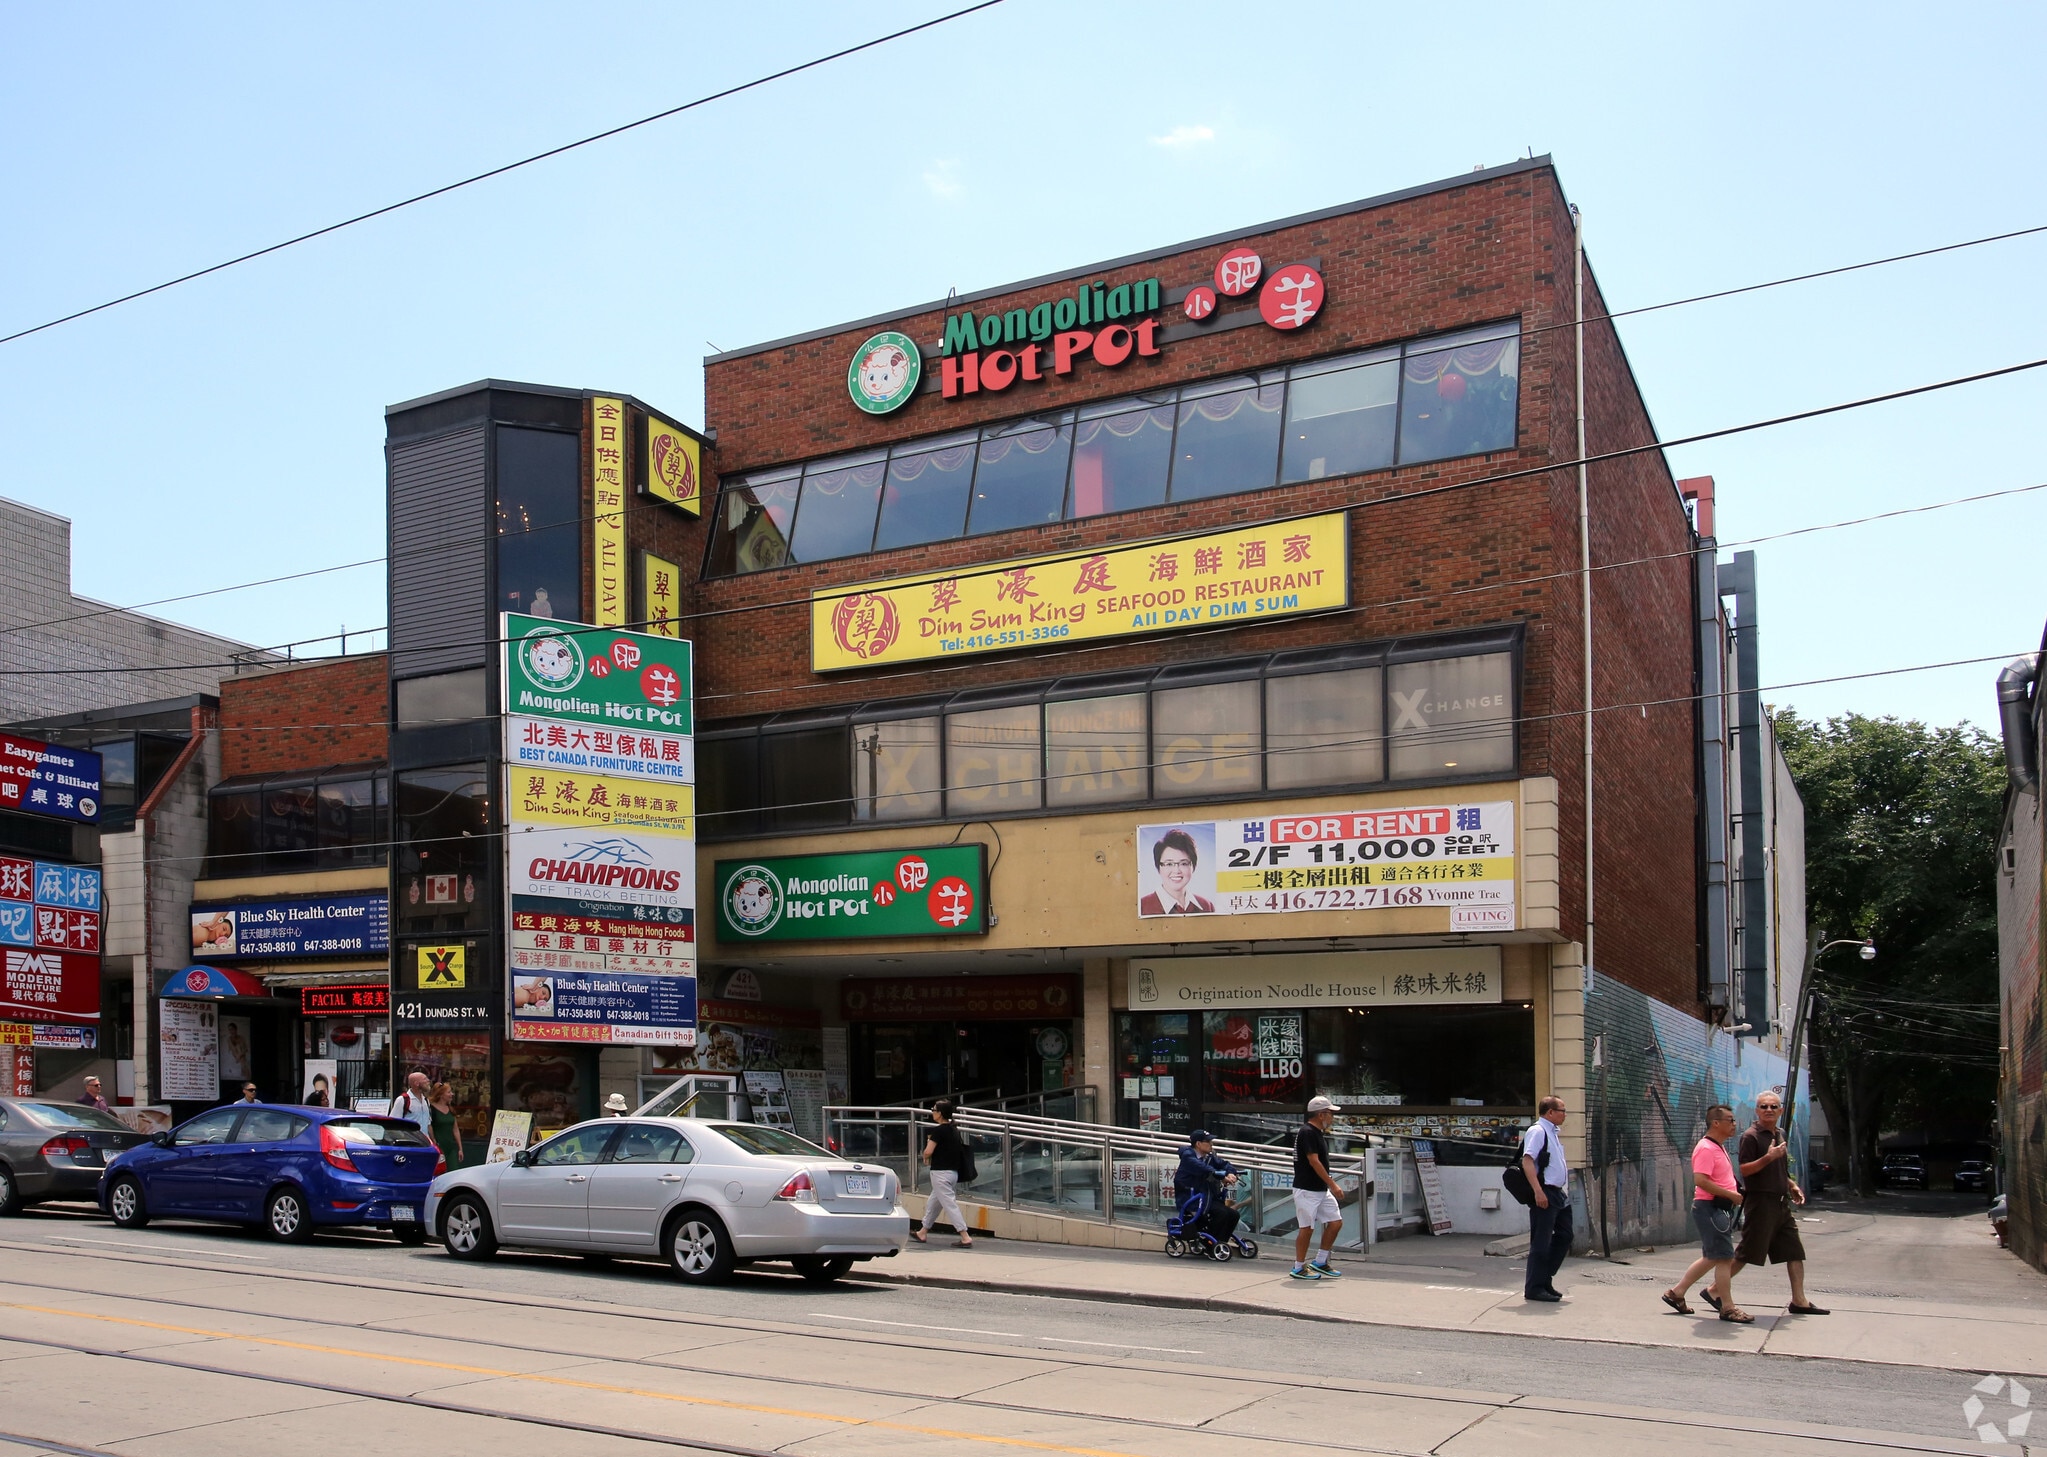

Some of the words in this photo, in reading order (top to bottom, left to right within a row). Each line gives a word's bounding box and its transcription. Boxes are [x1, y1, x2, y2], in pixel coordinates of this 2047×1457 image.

[1185, 256, 1317, 326] 小肥羊
[942, 277, 1160, 356] Mongolian
[941, 342, 1043, 398] Hot
[1054, 317, 1160, 375] Pot
[596, 403, 621, 530] 全日供應點心
[602, 537, 616, 571] ALL
[928, 555, 1117, 614] 翠濠庭
[1148, 534, 1312, 583] 海鮮酒家
[602, 577, 617, 617] DAY
[919, 615, 963, 638] Dim
[970, 608, 1022, 631] Sum
[1029, 601, 1086, 625] King
[1097, 588, 1186, 615] SEAFOOD
[1194, 569, 1325, 602] RESTAURANT
[1164, 606, 1202, 625] DAY
[1208, 600, 1248, 619] DIM
[1255, 593, 1299, 612] SUM
[589, 643, 678, 707] 小肥羊
[519, 690, 600, 716] Mongolian
[605, 702, 643, 721] Hot
[646, 707, 682, 726] Pot
[1051, 712, 1113, 734] LOUNGE
[523, 722, 681, 763] 北美大型傢俬展
[4, 742, 75, 768] Easygames
[519, 747, 545, 761] BEST
[548, 750, 588, 767] CANADA
[590, 755, 645, 773] FURNITURE
[647, 762, 683, 777] CENTRE
[16, 766, 42, 780] Cafe
[45, 771, 55, 782] &
[57, 774, 100, 791] Billiard
[526, 776, 612, 808] 翠濠庭
[616, 792, 678, 812] 海鮮酒家
[524, 800, 549, 815] Dim
[551, 803, 580, 817] Sum
[582, 806, 611, 822] King
[613, 810, 645, 821] Seafood
[645, 814, 686, 826] Restaurant
[613, 817, 627, 826] 421
[1456, 807, 1482, 831] 租
[1243, 821, 1265, 843] 出
[1276, 815, 1340, 841] FOR
[1353, 811, 1446, 836] RENT
[1444, 835, 1475, 846] SQ
[1444, 843, 1500, 856] FEET
[1228, 845, 1292, 869] 2/F
[1308, 837, 1436, 865] 11,000
[528, 857, 682, 892] CHAMPIONS
[787, 874, 869, 895] Mongolian
[1242, 867, 1371, 890] 二樓全層出租
[1381, 863, 1484, 882] 適合各行各業
[528, 884, 555, 894] OFF
[565, 886, 611, 900] TRACK
[620, 892, 678, 905] BETTING
[874, 861, 969, 927] 小肥羊
[1265, 886, 1424, 911] 416.722.7168
[1427, 888, 1475, 901] Yvonne
[1478, 888, 1502, 900] Trac
[240, 910, 265, 924] Blue
[266, 909, 286, 925] Sky
[287, 907, 325, 921] Health
[326, 905, 366, 918] Center
[579, 900, 625, 913] Origination
[786, 901, 825, 919] Hot
[829, 898, 869, 917] Pot
[1457, 909, 1508, 924] LIVING
[608, 922, 627, 937] Hang
[627, 924, 644, 938] Hing
[645, 926, 663, 940] Hong
[664, 927, 686, 939] Foods
[240, 941, 296, 954] 647-350-8810
[304, 938, 362, 951] 647-388-0018
[533, 933, 673, 956] 保康園藥材行
[6, 971, 62, 985] MODERN
[6, 981, 62, 992] FURNITURE
[557, 978, 577, 990] Blue
[577, 980, 592, 993] Sky
[593, 981, 621, 993] Health
[621, 983, 649, 994] Center
[736, 972, 752, 983] 421
[1393, 971, 1487, 996] 緣味米線
[12, 990, 58, 1003] 現代傢俬
[312, 994, 347, 1006] FACIAL
[1178, 986, 1264, 1005] Origination
[1267, 983, 1324, 999] Noodle
[1328, 981, 1377, 997] House
[396, 1002, 422, 1018] 421
[425, 1008, 459, 1018] DUNDAS
[461, 1007, 475, 1017] ST.
[477, 1006, 489, 1017] W.
[557, 1008, 601, 1019] 647-350-8810
[606, 1010, 650, 1021] 647-388-0018
[0, 1024, 31, 1034] LEASE
[614, 1029, 654, 1039] Canadian
[655, 1030, 672, 1040] Gift
[673, 1030, 694, 1041] Shop
[1260, 1058, 1303, 1079] LLBO
